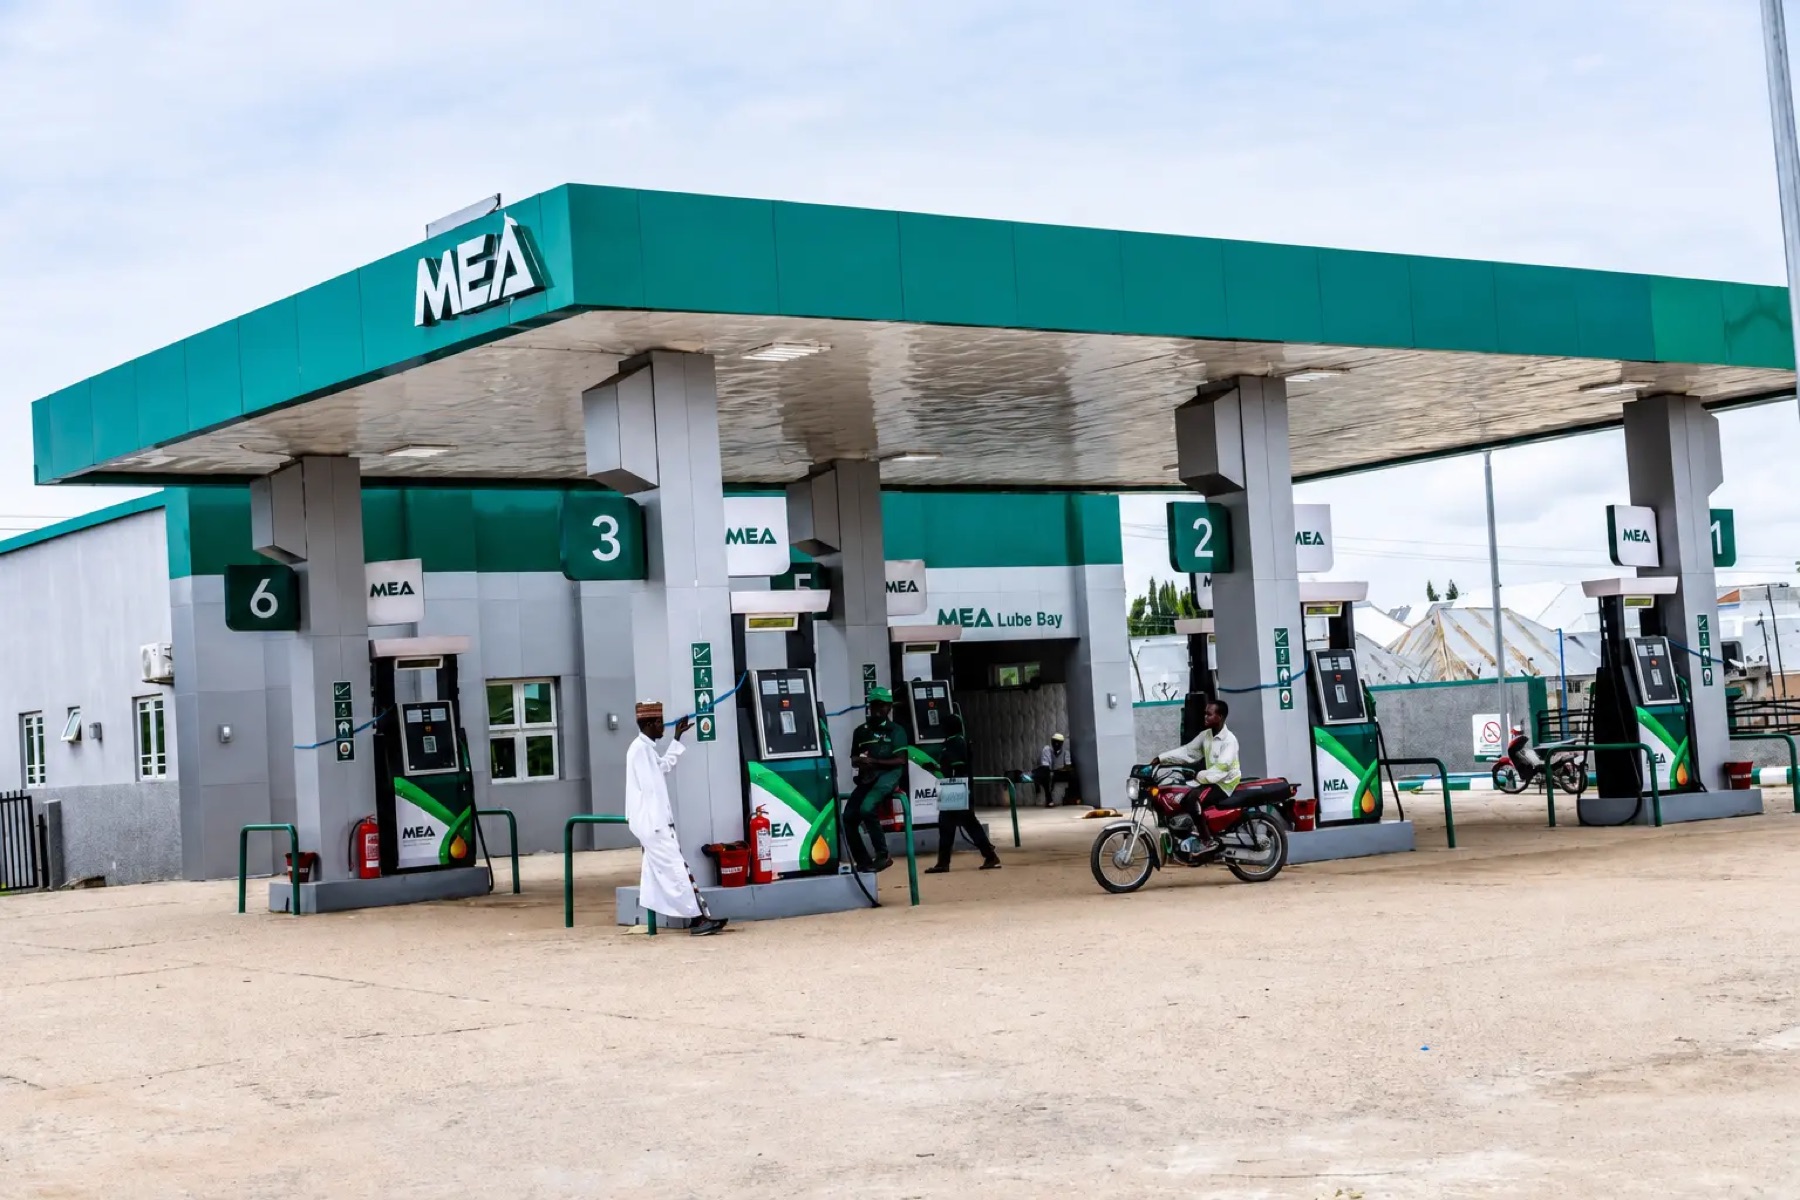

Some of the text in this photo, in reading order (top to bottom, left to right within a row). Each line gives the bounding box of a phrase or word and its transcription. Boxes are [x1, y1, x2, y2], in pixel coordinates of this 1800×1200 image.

[415, 211, 536, 327] MEA
[592, 514, 621, 562] 3
[725, 527, 777, 545] MEA
[1192, 517, 1214, 558] 2
[1623, 528, 1651, 543] MEA
[1711, 519, 1723, 555] 1
[370, 581, 415, 597] MEA
[885, 579, 920, 593] MEA
[250, 578, 279, 619] 6
[937, 607, 1063, 629] MEA Lube Bay
[1646, 753, 1666, 764] EA
[1323, 778, 1349, 791] MEA
[914, 788, 938, 799] MEA
[402, 825, 436, 839] MEA
[769, 822, 795, 838] EA
